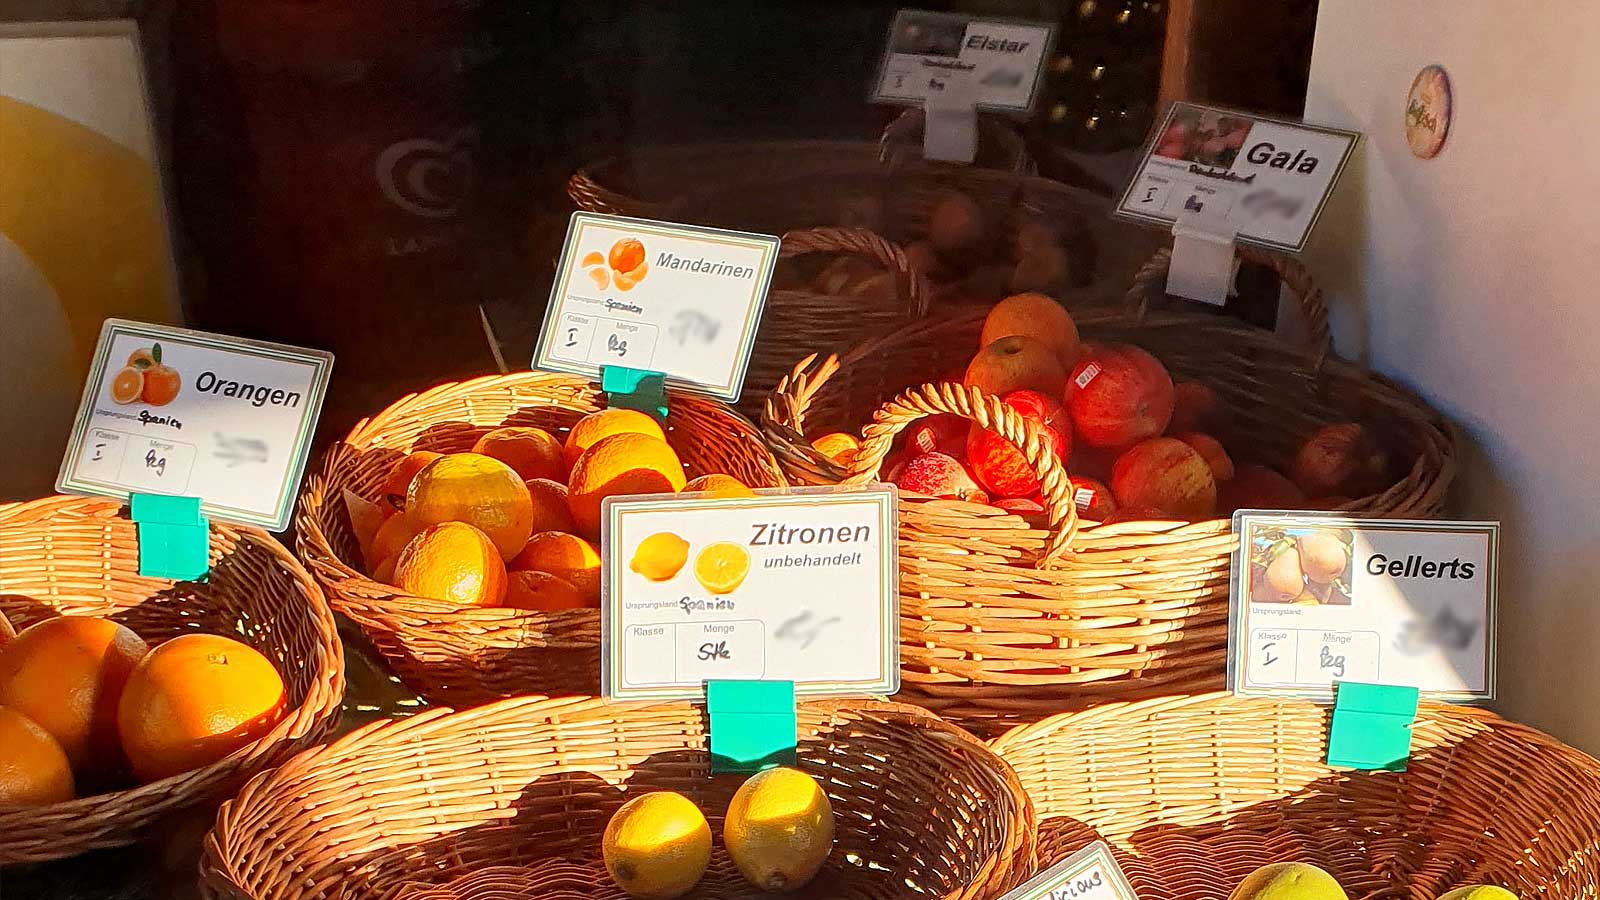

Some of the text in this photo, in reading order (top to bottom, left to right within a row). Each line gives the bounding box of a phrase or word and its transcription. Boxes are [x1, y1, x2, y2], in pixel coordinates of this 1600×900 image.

[967, 35, 1029, 54] Elstar
[1246, 142, 1319, 174] Gala
[656, 252, 754, 279] Mandarinen
[195, 371, 300, 408] Orangen
[137, 410, 182, 430] Spanien
[749, 524, 871, 546] Zitronen
[764, 552, 863, 569] unbehandelt
[1366, 554, 1476, 579] Gellerts
[633, 627, 664, 636] Klasse
[703, 624, 735, 634] Menge
[1258, 632, 1287, 640] Klasse
[1322, 632, 1352, 643] Menge
